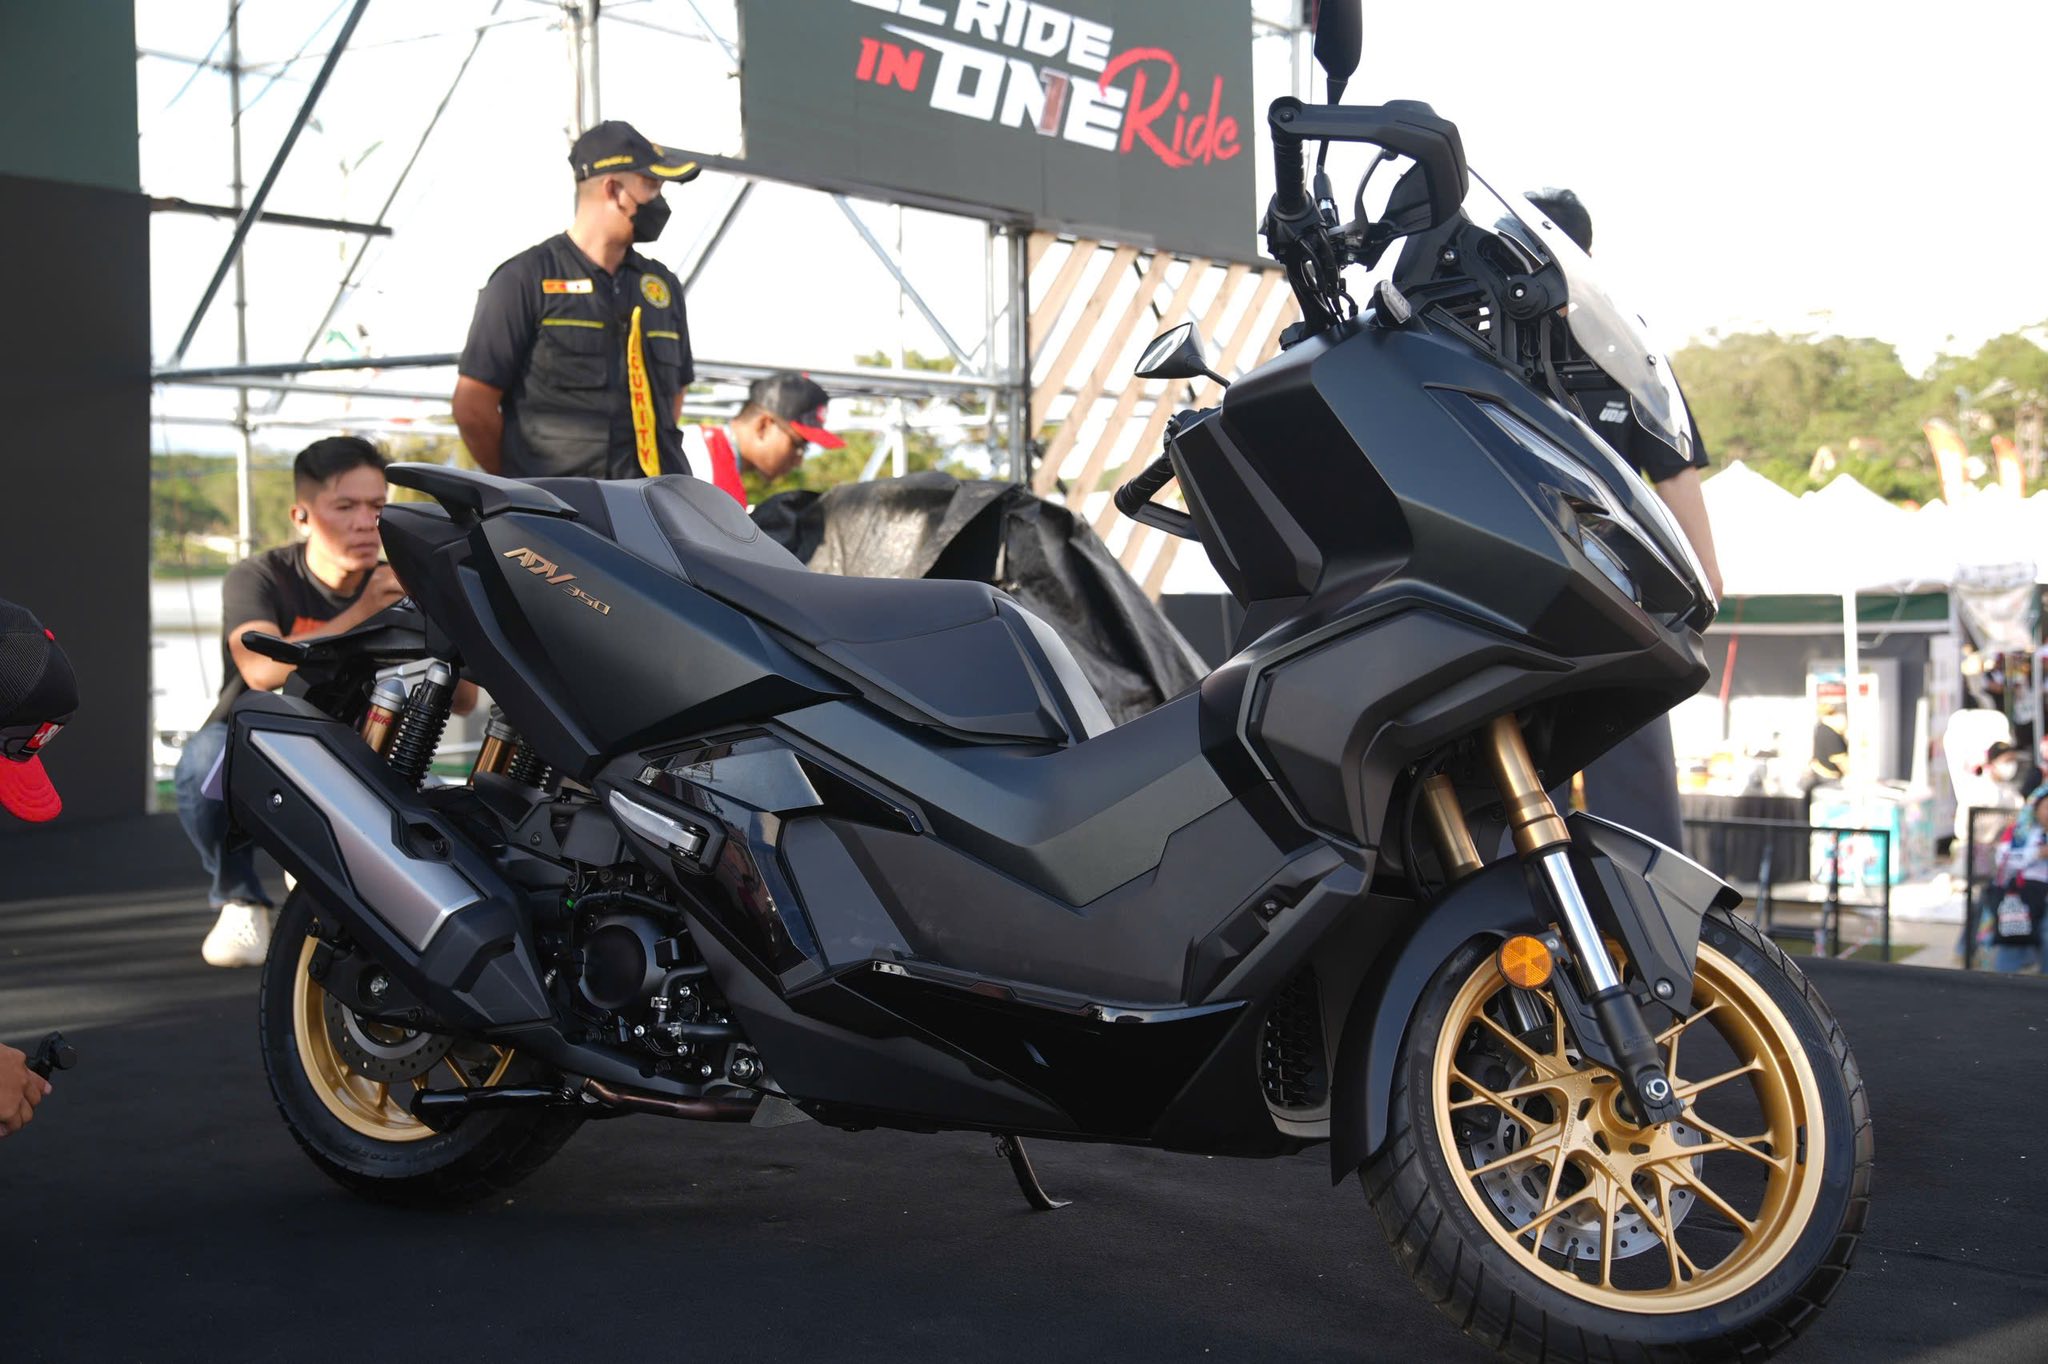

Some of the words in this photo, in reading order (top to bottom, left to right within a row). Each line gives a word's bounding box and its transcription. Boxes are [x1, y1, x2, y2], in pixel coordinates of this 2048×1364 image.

[953, 0, 1113, 72] RIDE
[855, 37, 926, 92] IN
[1100, 47, 1241, 168] Ride
[503, 547, 577, 585] ADV
[562, 583, 611, 615] 350
